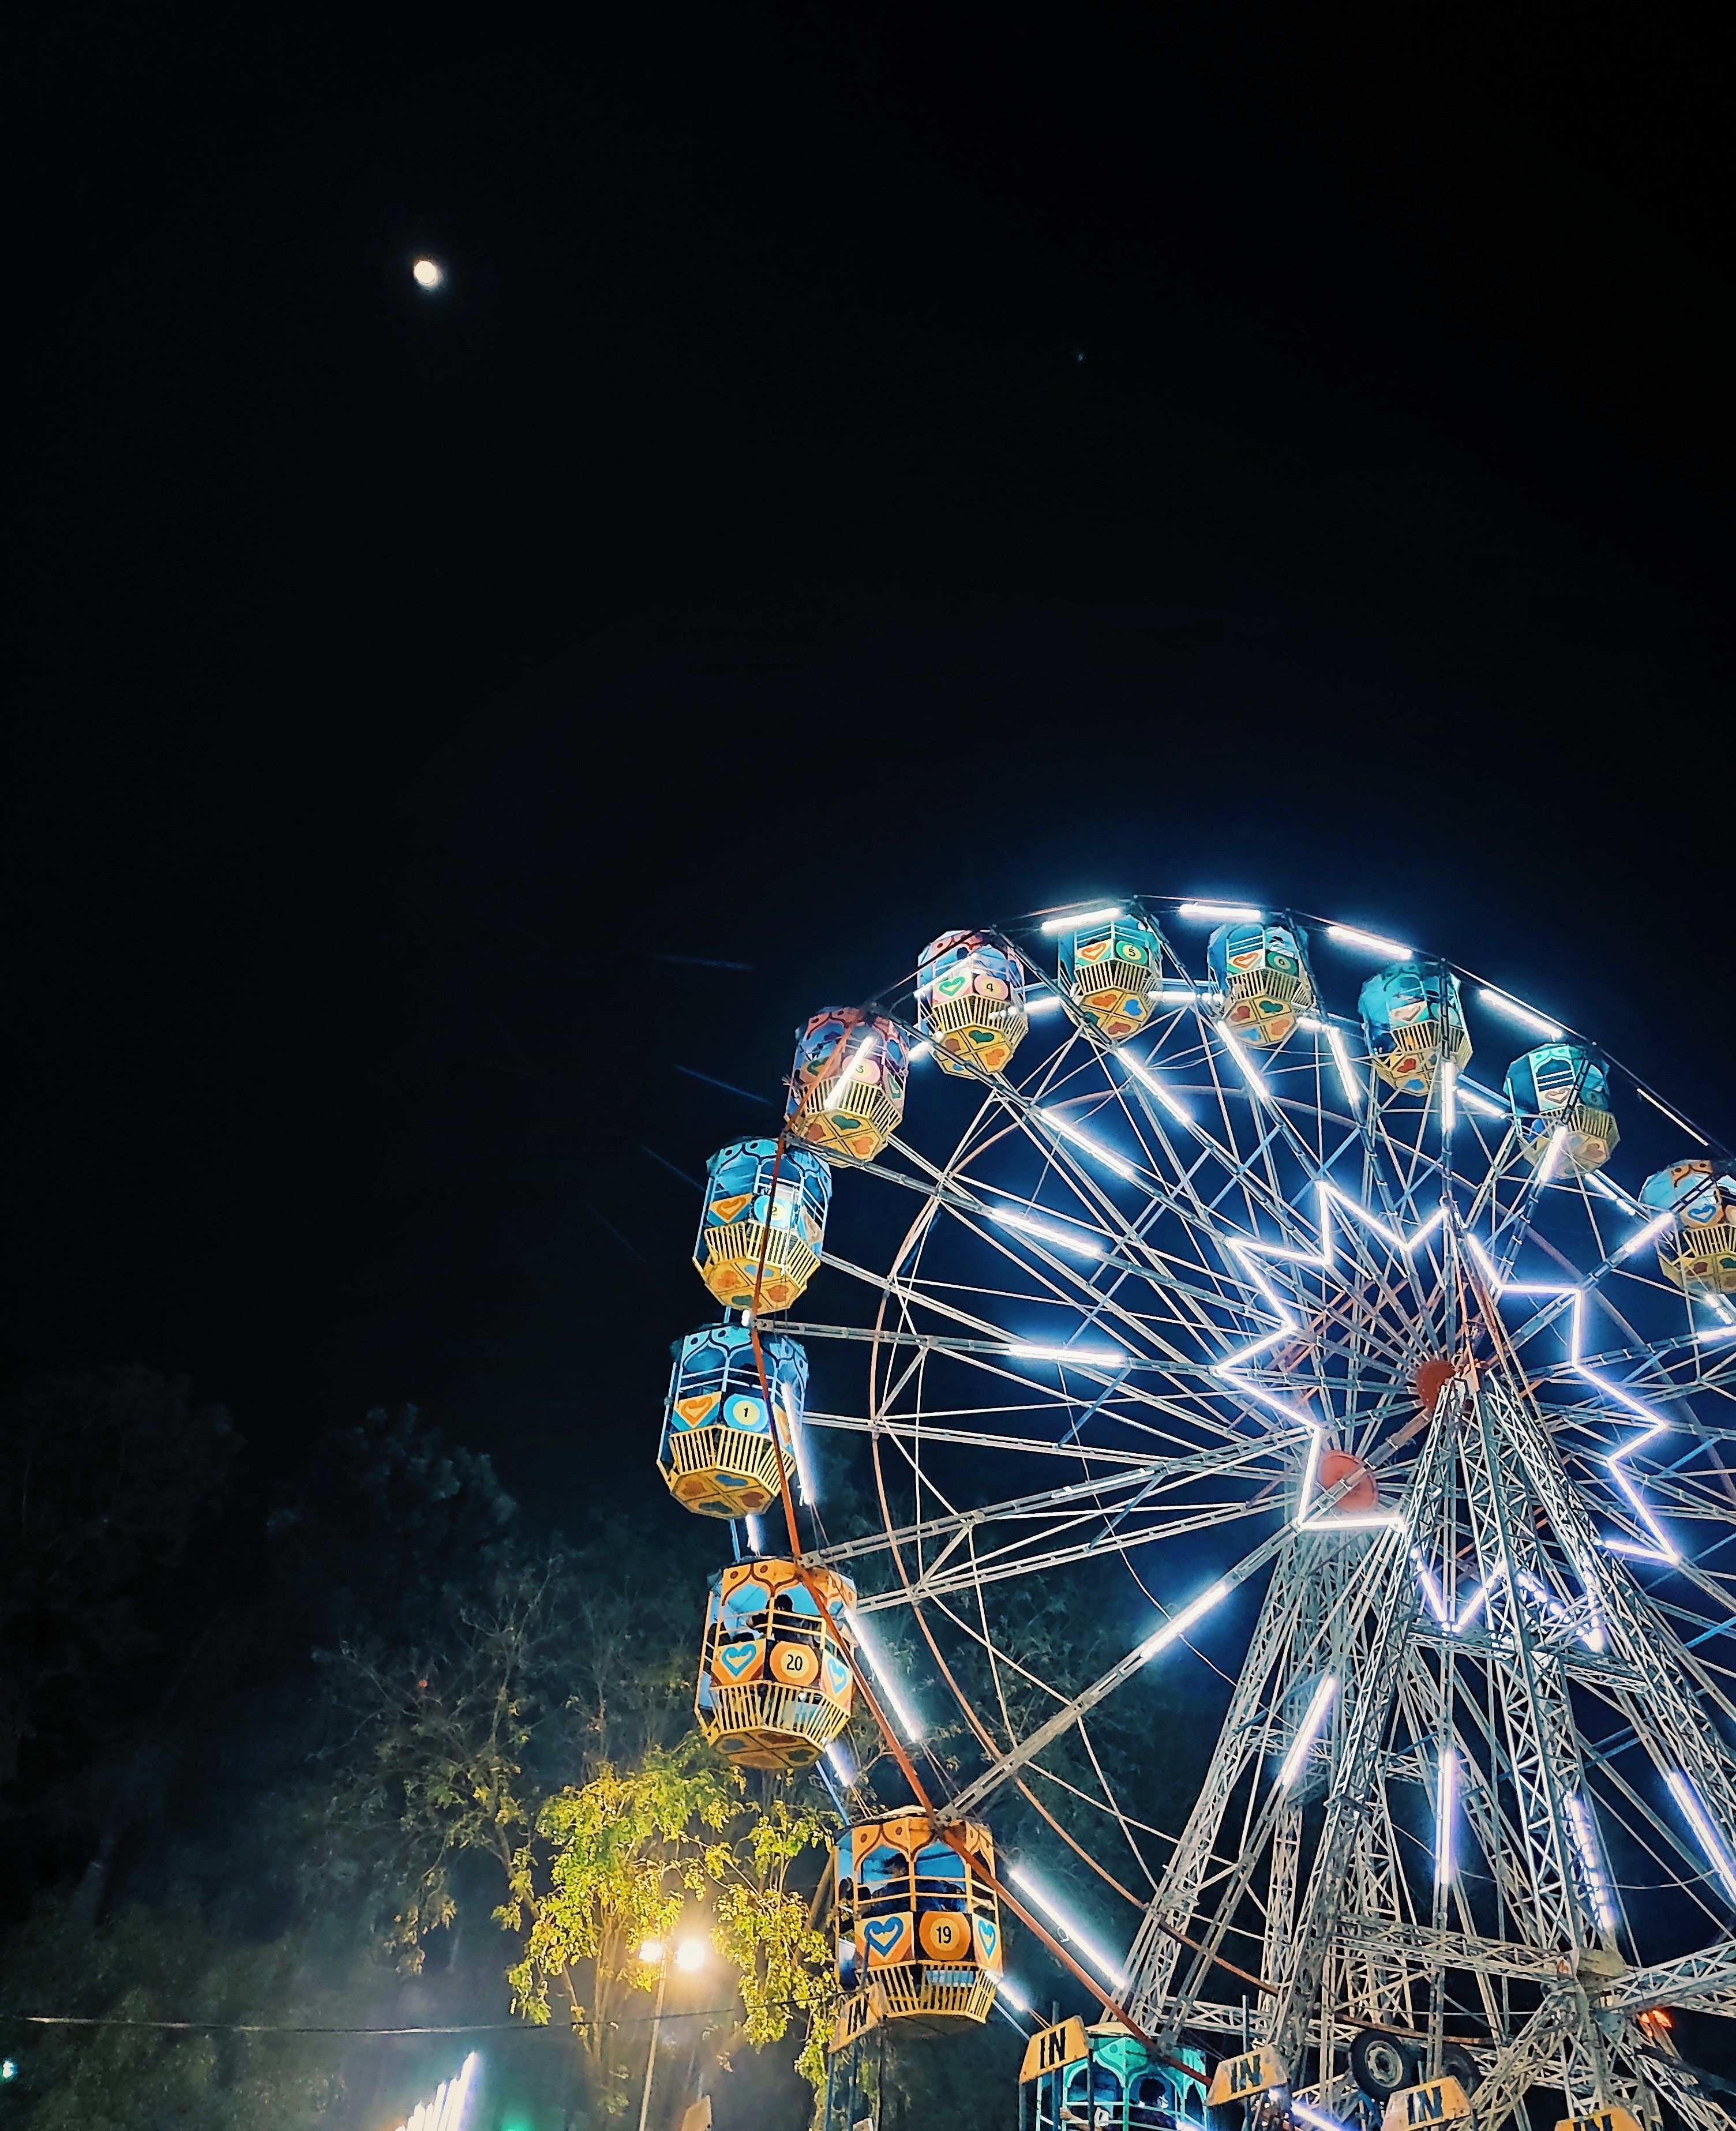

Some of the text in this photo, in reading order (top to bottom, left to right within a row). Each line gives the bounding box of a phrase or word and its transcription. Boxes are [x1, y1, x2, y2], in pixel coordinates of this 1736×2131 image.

[1128, 947, 1136, 956] 5
[986, 983, 993, 992] 4
[855, 1064, 864, 1074] 3
[744, 1408, 749, 1417] 1
[786, 1654, 803, 1671] 20
[936, 1926, 951, 1944] 19
[846, 1994, 869, 2036] IN
[1040, 2026, 1066, 2070] IN
[1231, 2054, 1262, 2095] IN
[1407, 2085, 1443, 2125] IN
[1573, 2113, 1614, 2131] N
